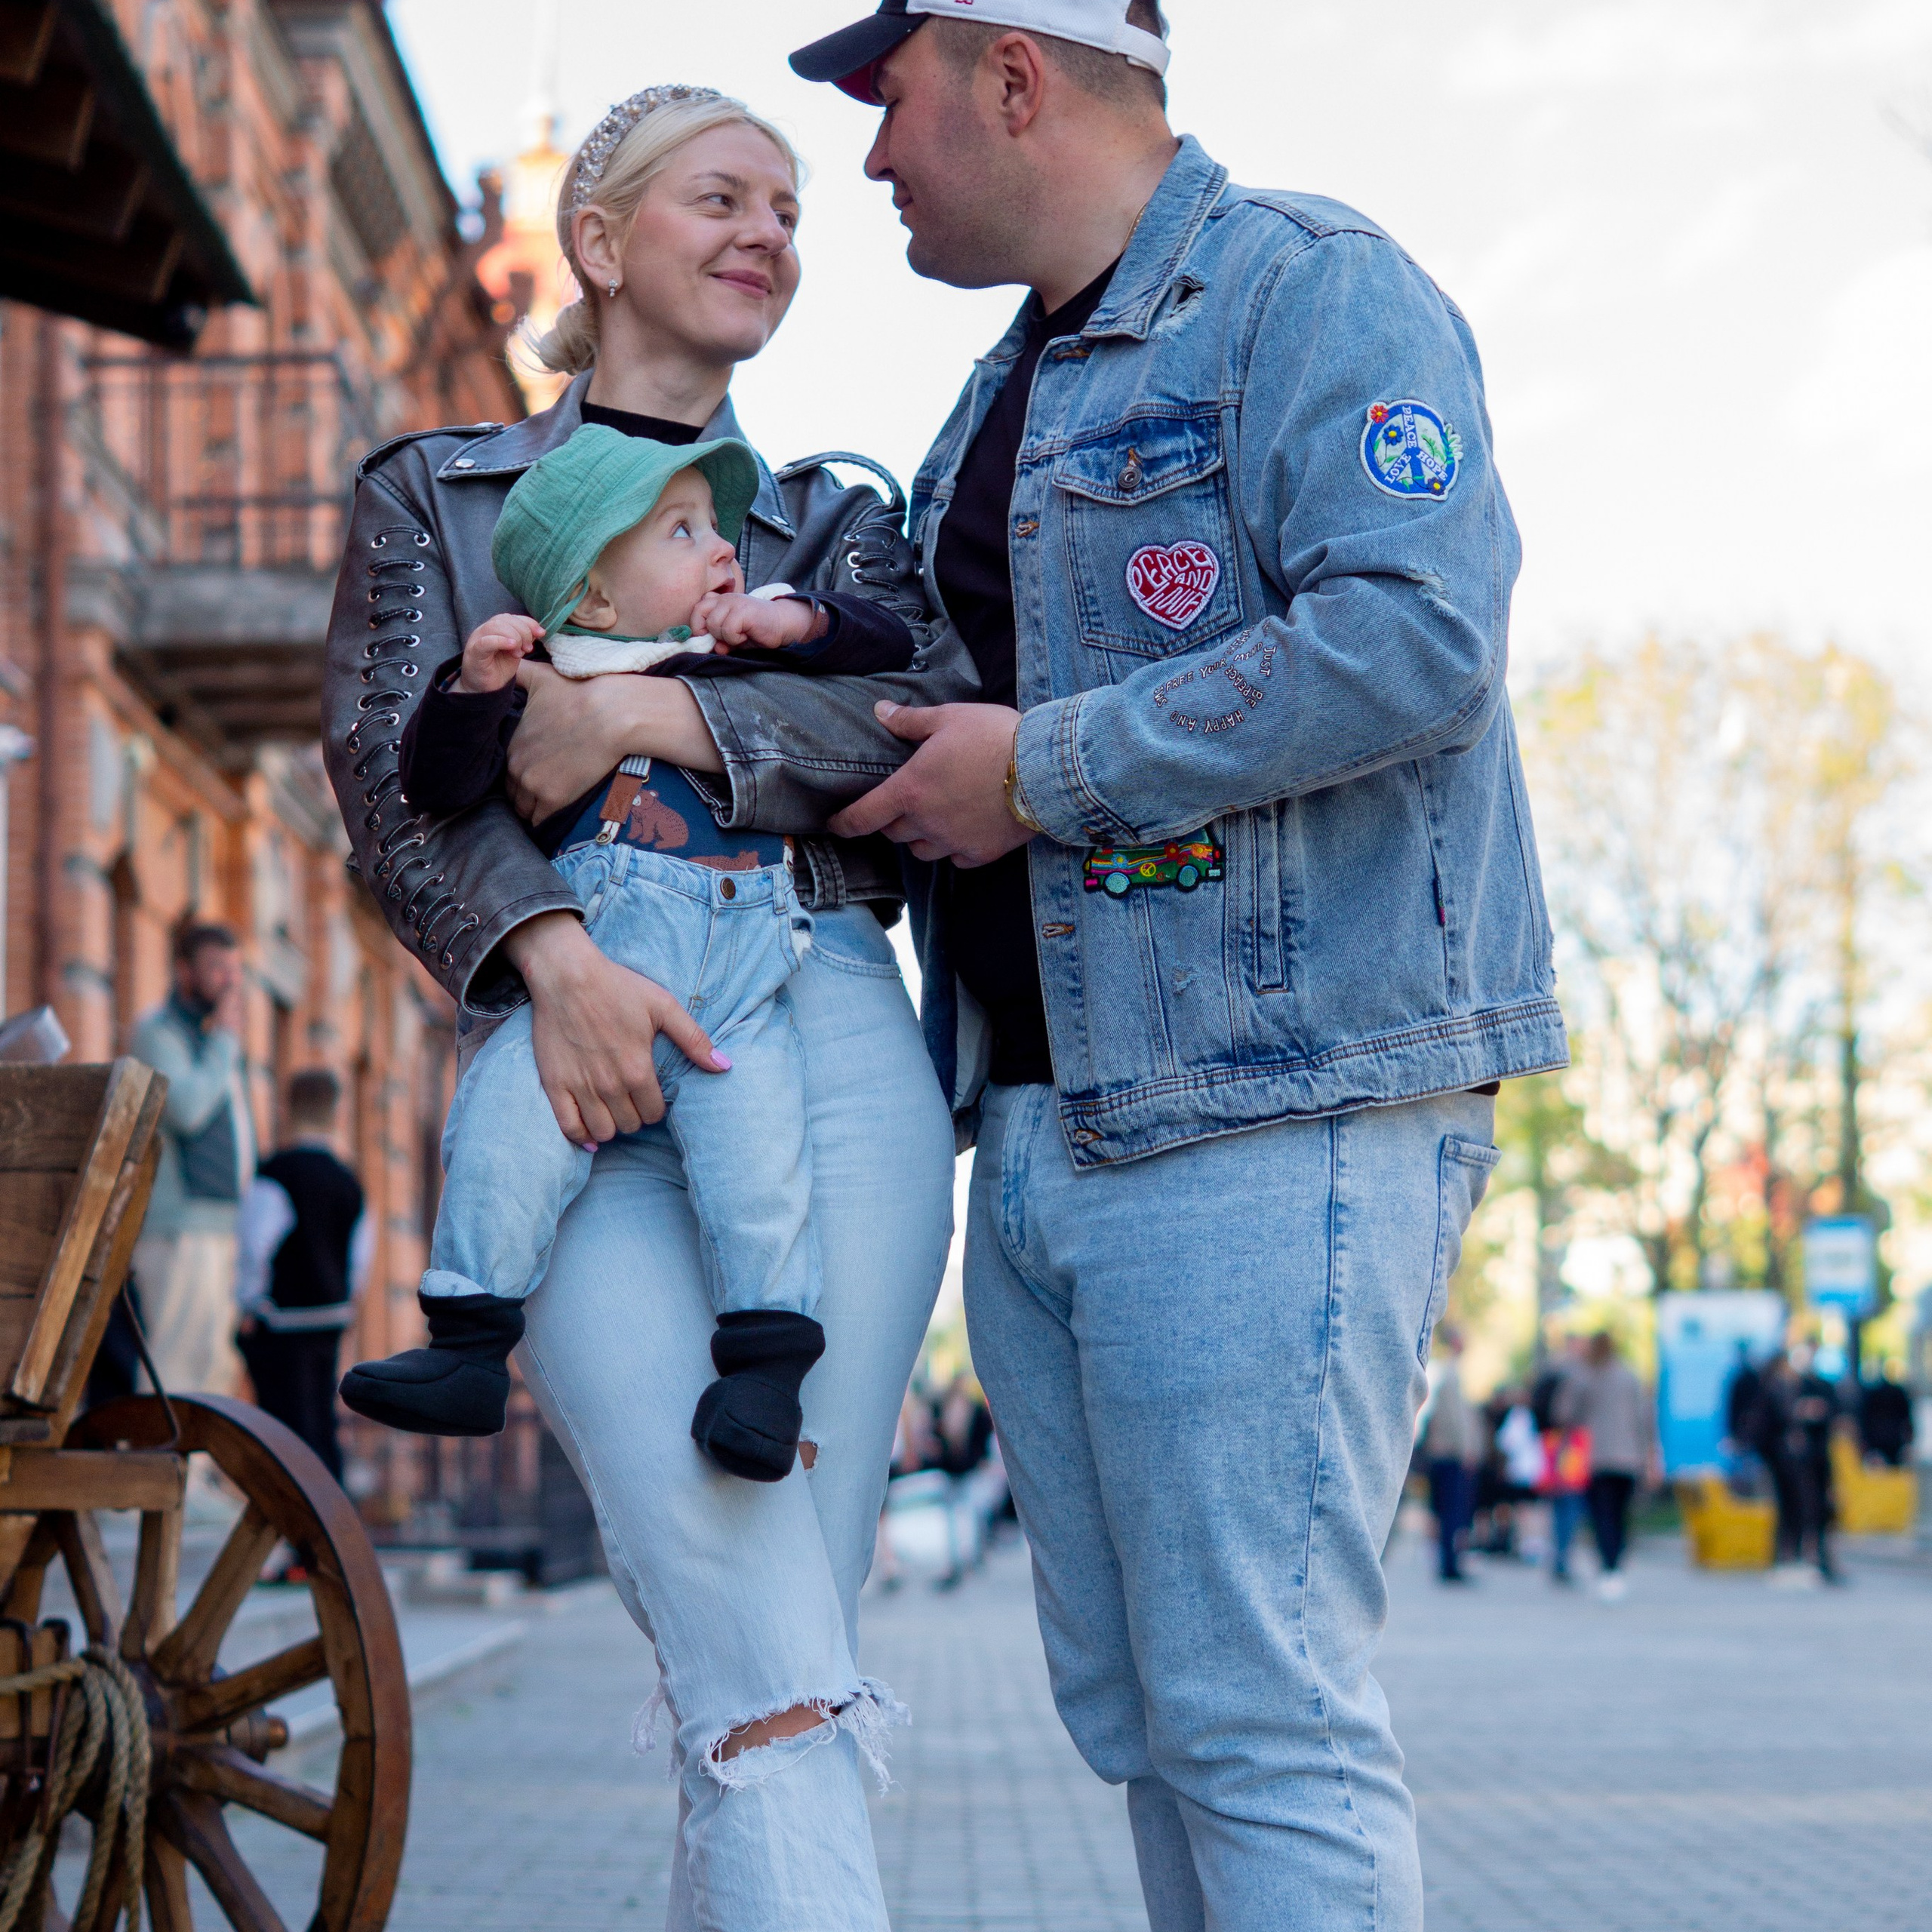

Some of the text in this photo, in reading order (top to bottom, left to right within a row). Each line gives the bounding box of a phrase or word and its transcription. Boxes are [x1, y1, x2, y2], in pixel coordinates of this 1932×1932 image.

[1401, 405, 1417, 449] PEACE
[1384, 453, 1412, 485] LOVE
[1416, 451, 1448, 481] HOPE
[1132, 547, 1214, 594] PEACE
[1174, 568, 1214, 592] AND
[1142, 582, 1204, 622] LOVE
[1165, 641, 1263, 692] FREE YOUR MIND
[1260, 645, 1278, 677] JUST
[1224, 664, 1253, 697] PEACE
[1244, 689, 1264, 709] BE
[1171, 710, 1197, 731] AND
[1204, 709, 1245, 734] HAPPY
